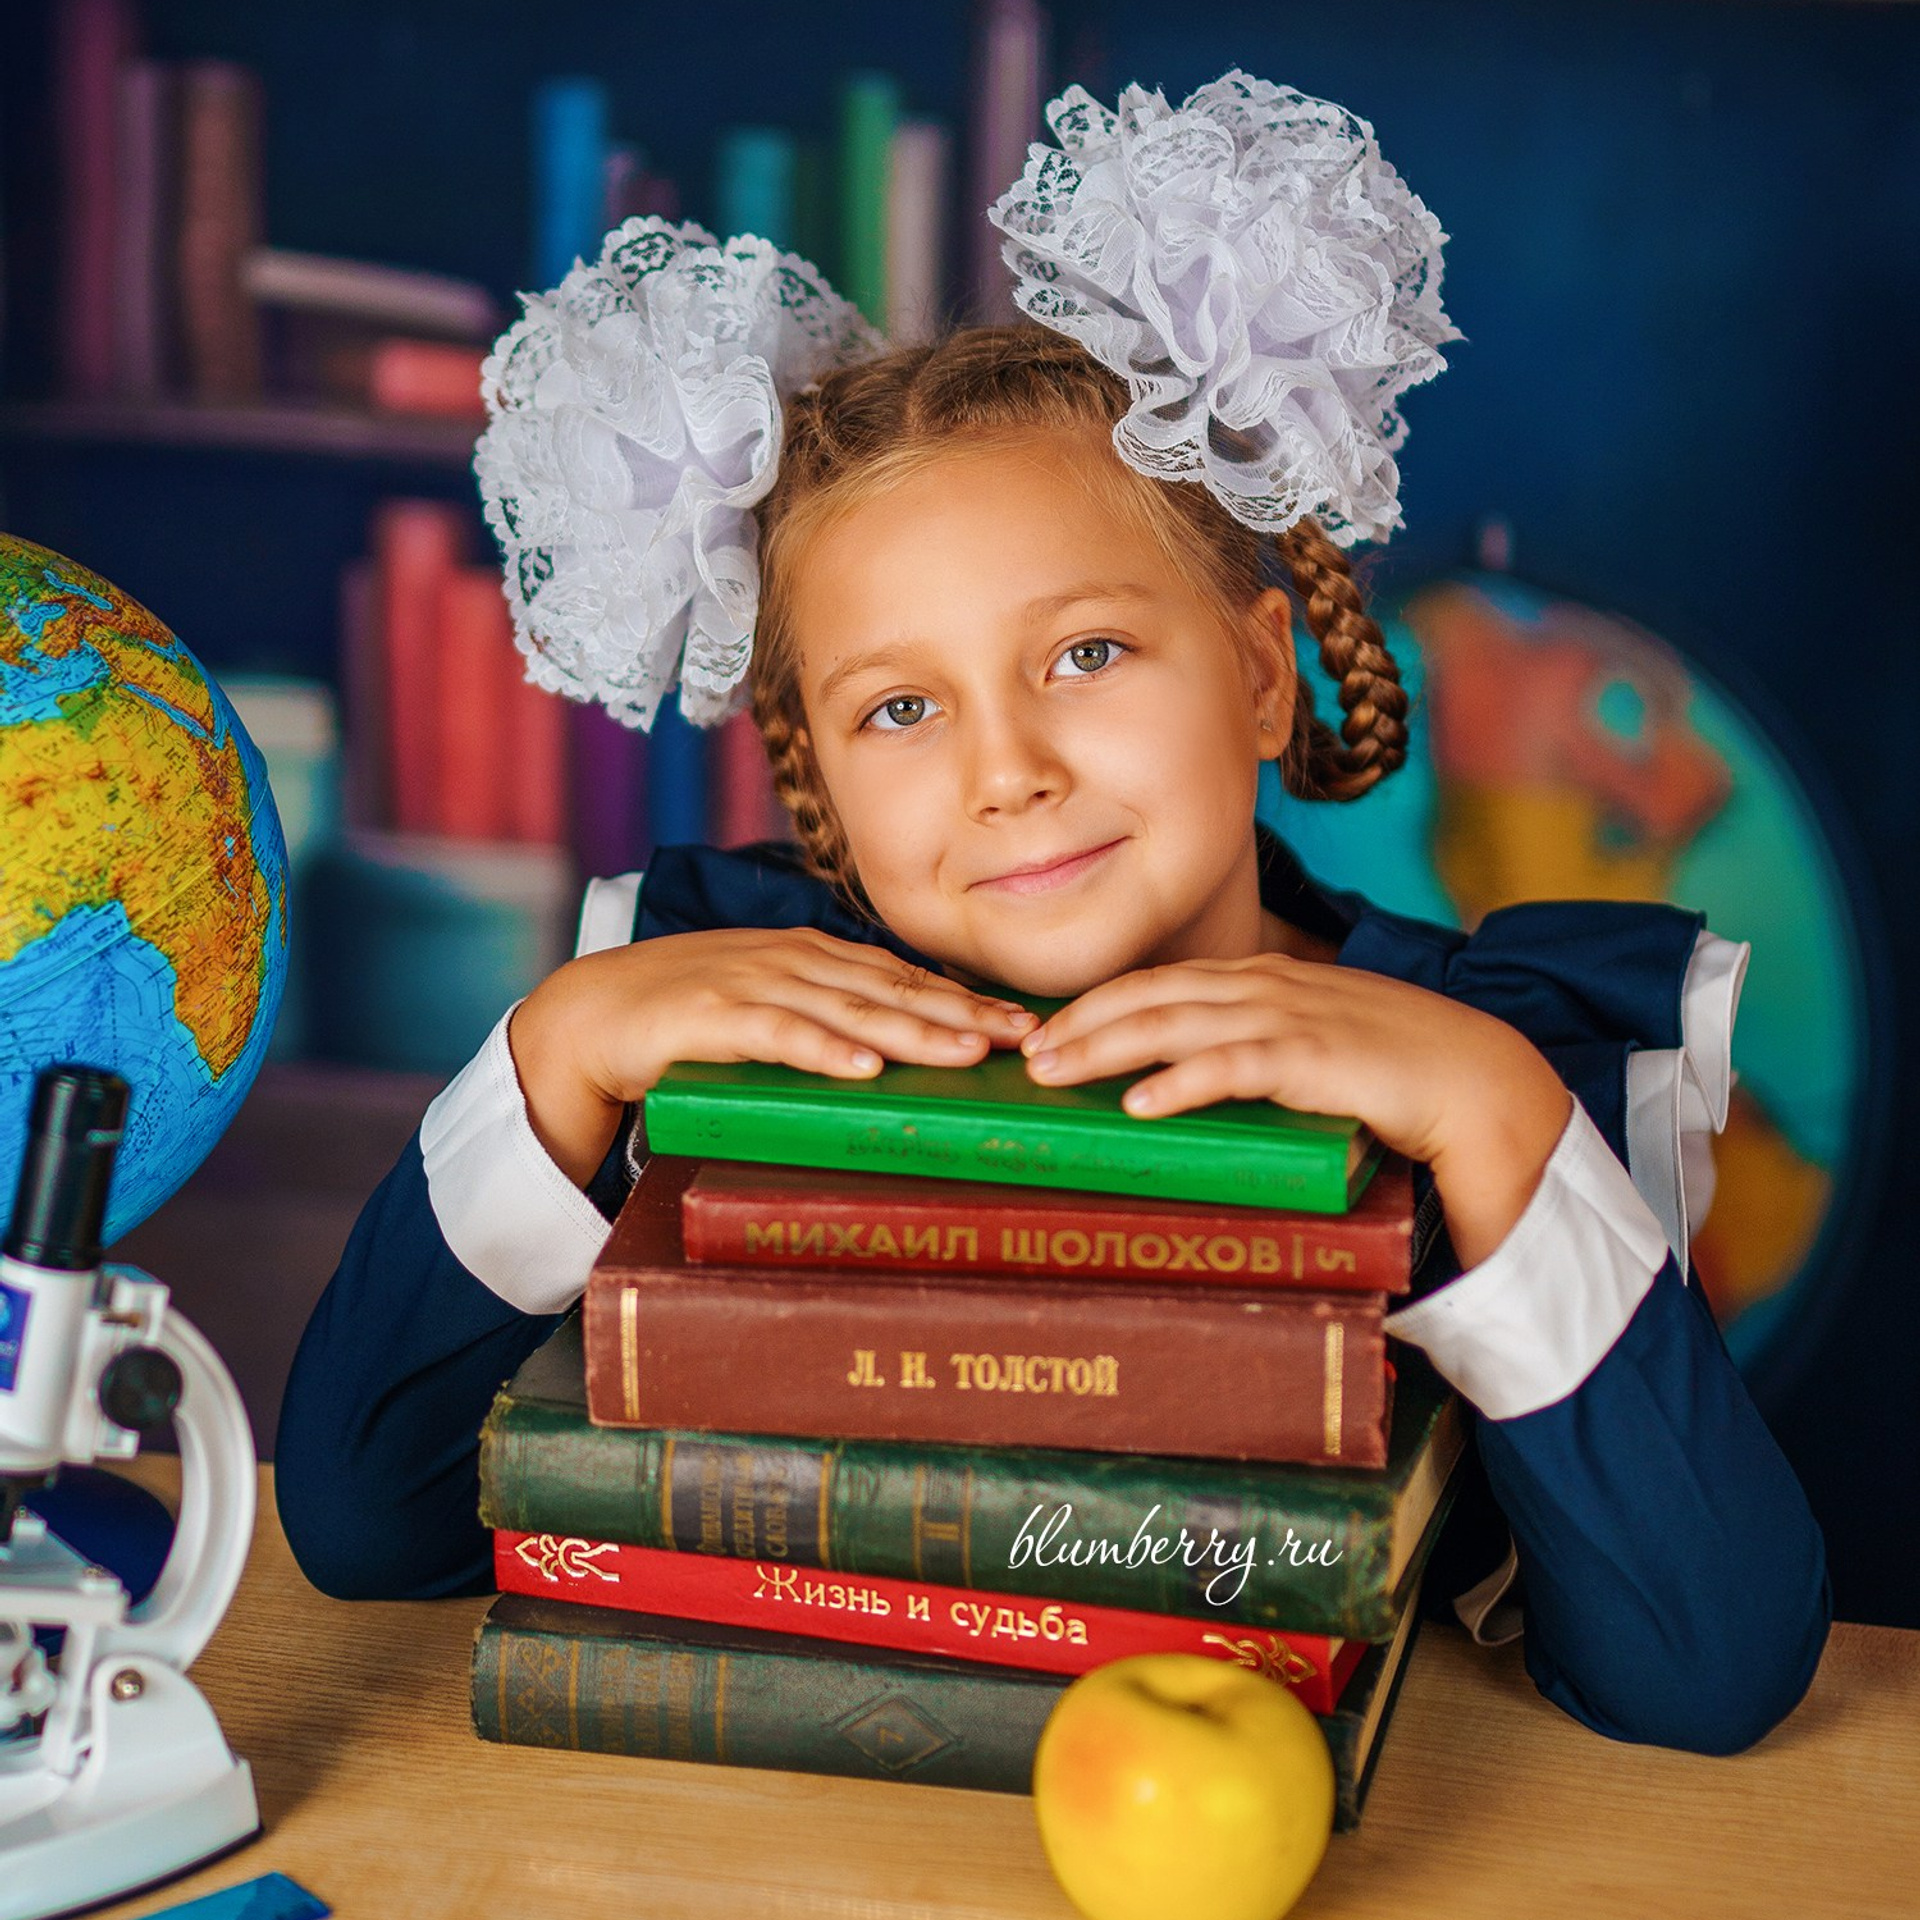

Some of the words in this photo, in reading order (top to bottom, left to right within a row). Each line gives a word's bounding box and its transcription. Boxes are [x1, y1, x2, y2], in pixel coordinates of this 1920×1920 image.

[745, 1220, 979, 1262] МИХАИЛ
[1001, 1228, 1283, 1275] ШОЛОХОВ
[1314, 1246, 1357, 1273] 5
[847, 1349, 886, 1387] Л.
[900, 1351, 937, 1389] Н.
[949, 1352, 1120, 1396] ТОЛСТОЙ
[753, 1564, 892, 1616] Жизнь
[906, 1593, 931, 1622] и
[949, 1600, 1089, 1646] судьба
